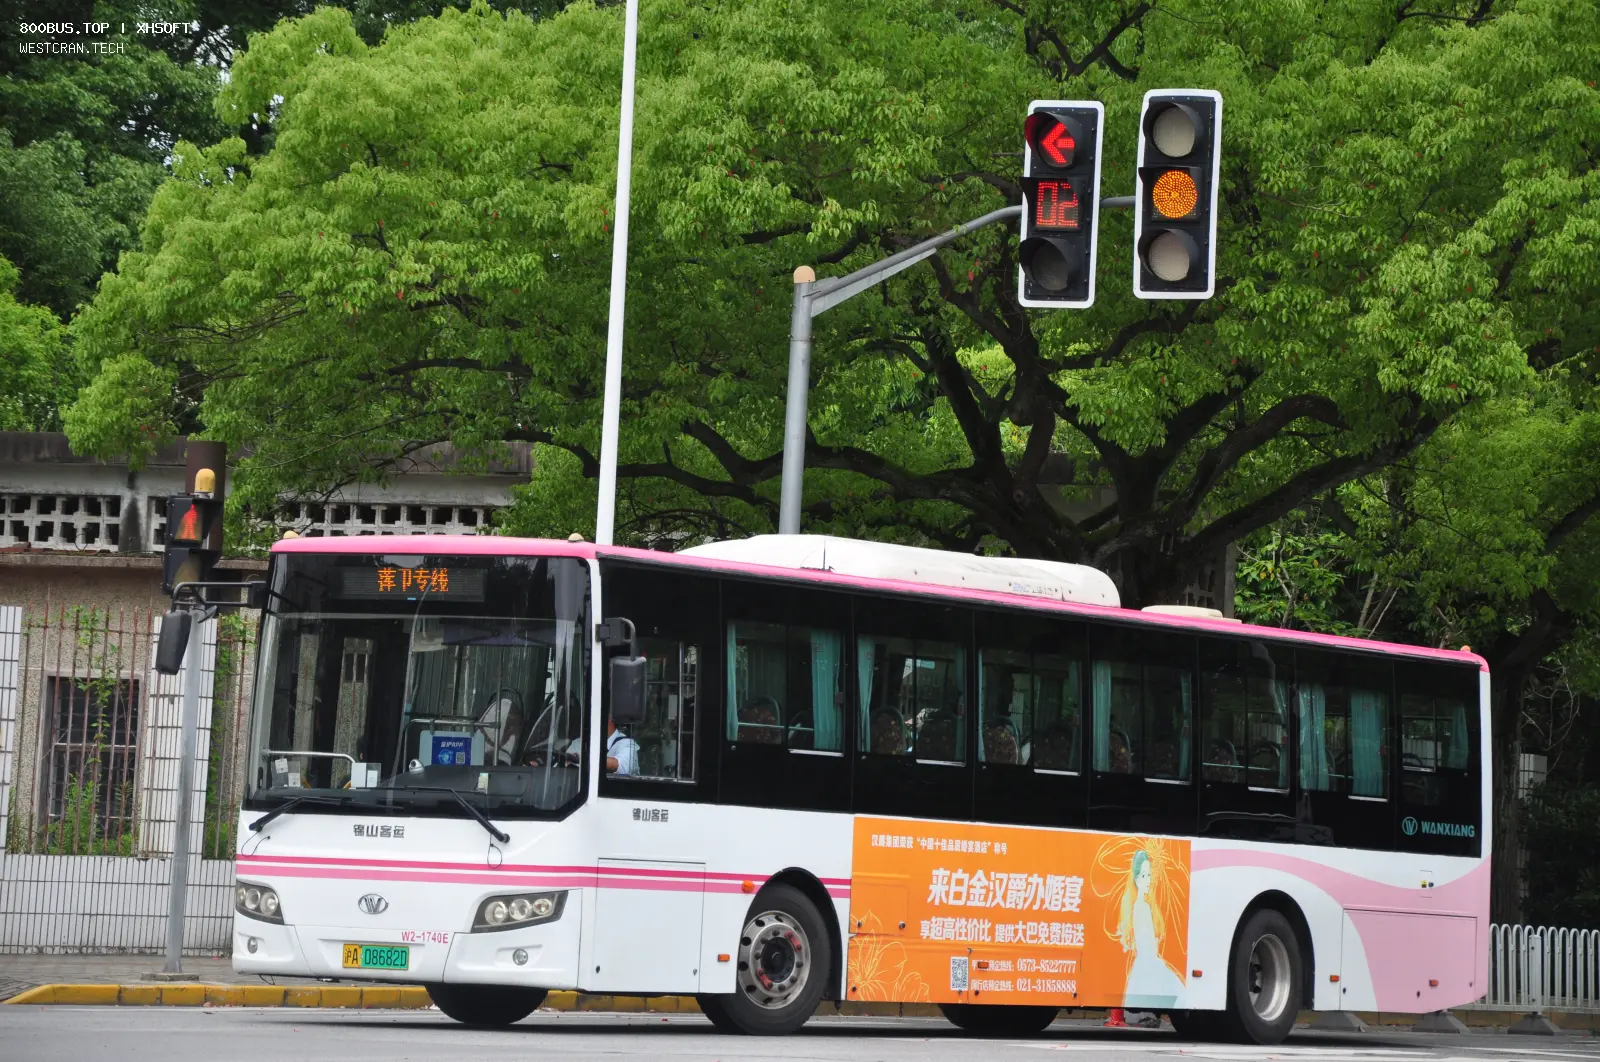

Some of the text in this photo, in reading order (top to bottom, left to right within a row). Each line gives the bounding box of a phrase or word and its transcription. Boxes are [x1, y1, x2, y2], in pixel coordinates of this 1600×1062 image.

[1036, 181, 1078, 227] 02
[1421, 821, 1475, 837] WANXIANG
[927, 867, 1084, 913] 来白金汉爵办婚宴
[401, 931, 449, 944] W2-1740E
[920, 916, 1085, 947] 享超高性价比 提供大巴免费接送
[344, 947, 408, 967] 沪A 08682D
[1017, 958, 1077, 973] 0573-85227777
[1016, 978, 1077, 993] 021-31858888
